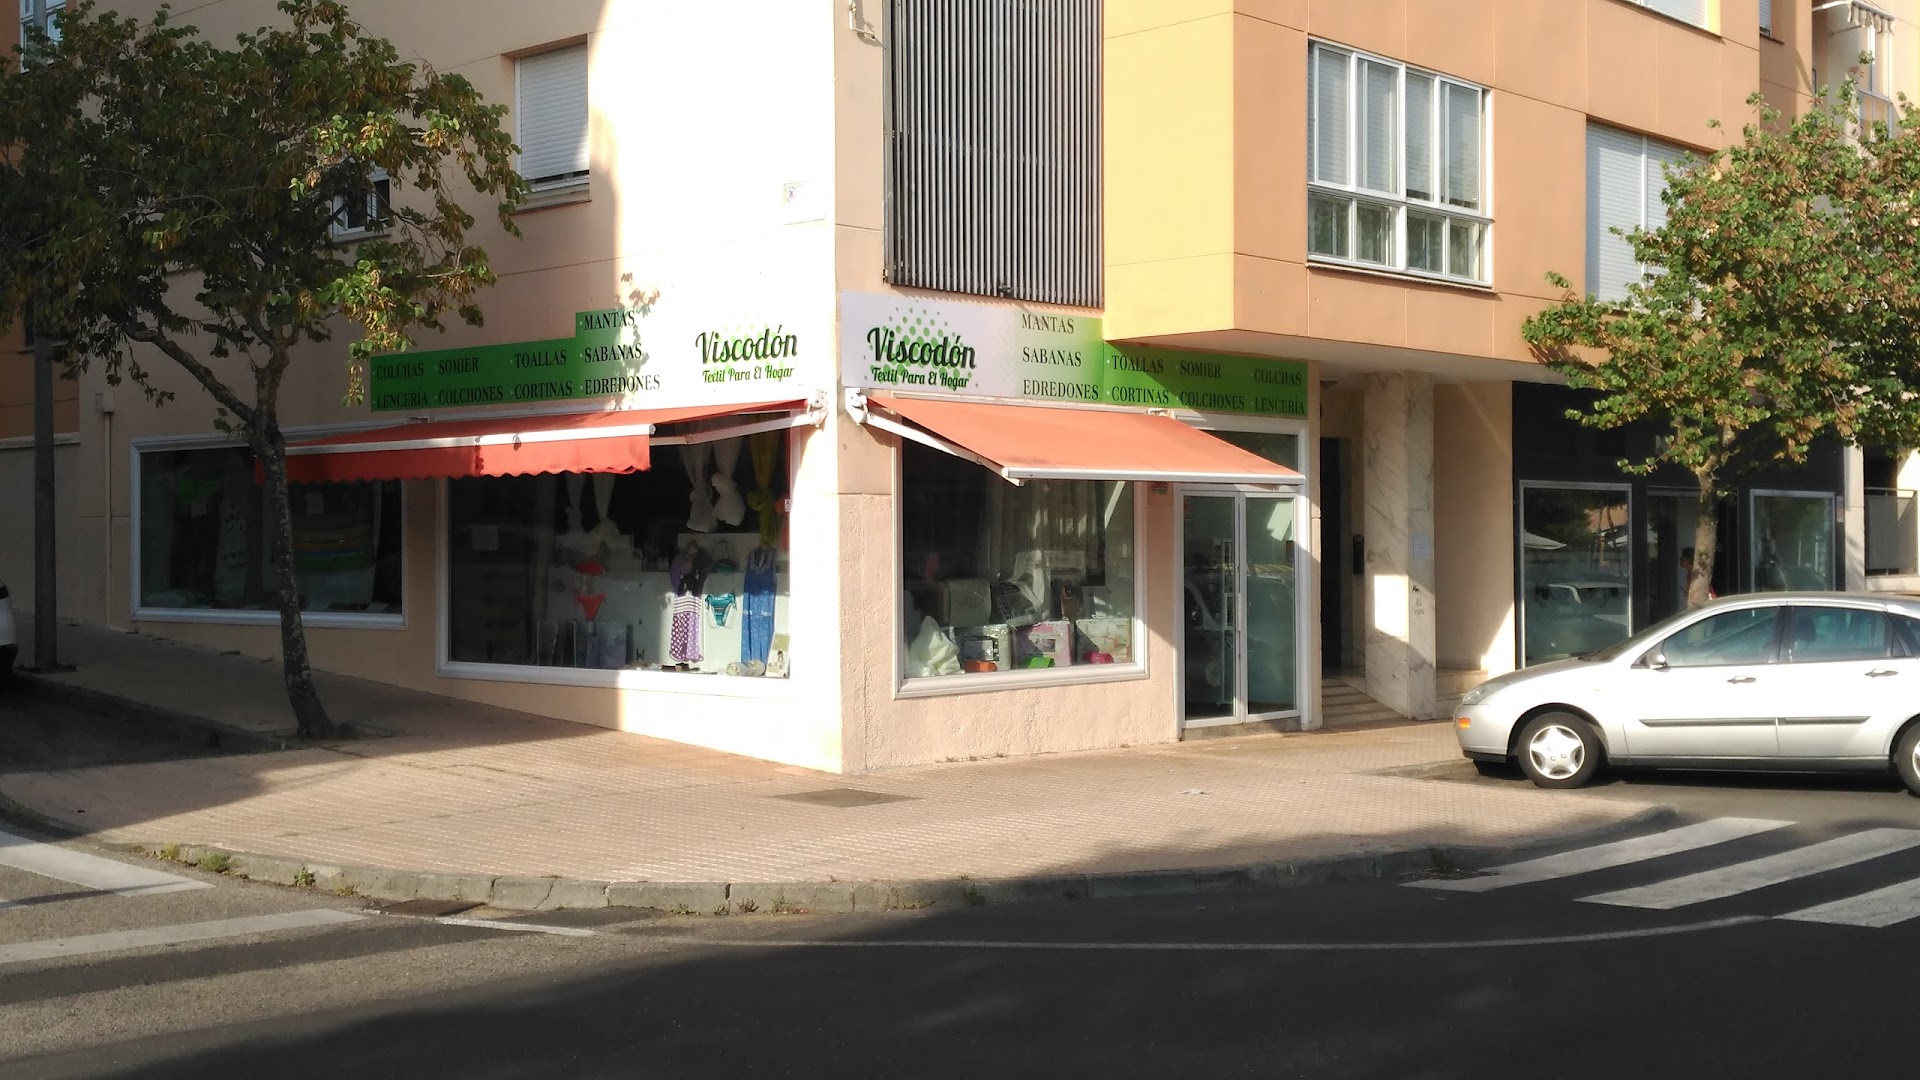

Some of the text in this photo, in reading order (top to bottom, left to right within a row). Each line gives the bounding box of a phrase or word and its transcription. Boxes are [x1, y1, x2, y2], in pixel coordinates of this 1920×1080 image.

[584, 310, 635, 331] MANTAS
[1021, 313, 1075, 334] MANTAS
[695, 324, 798, 364] Viscodón
[866, 327, 977, 369] Viscodón
[377, 343, 642, 380] COLCHAS SOMIER TOALLAS SABANAS
[702, 364, 795, 384] Textil Para El Hogar
[1022, 347, 1301, 386] SABANAS TOALLAS SOMIER COLCHAS
[439, 385, 503, 405] COLCHONES
[514, 381, 573, 400] CORTINAS
[584, 374, 660, 395] EDREDONES
[871, 367, 970, 391] Textil Para El Hogar
[1023, 379, 1099, 401] EDREDONES
[1111, 386, 1169, 405] CORTINAS
[1180, 391, 1245, 410] COLCHONES
